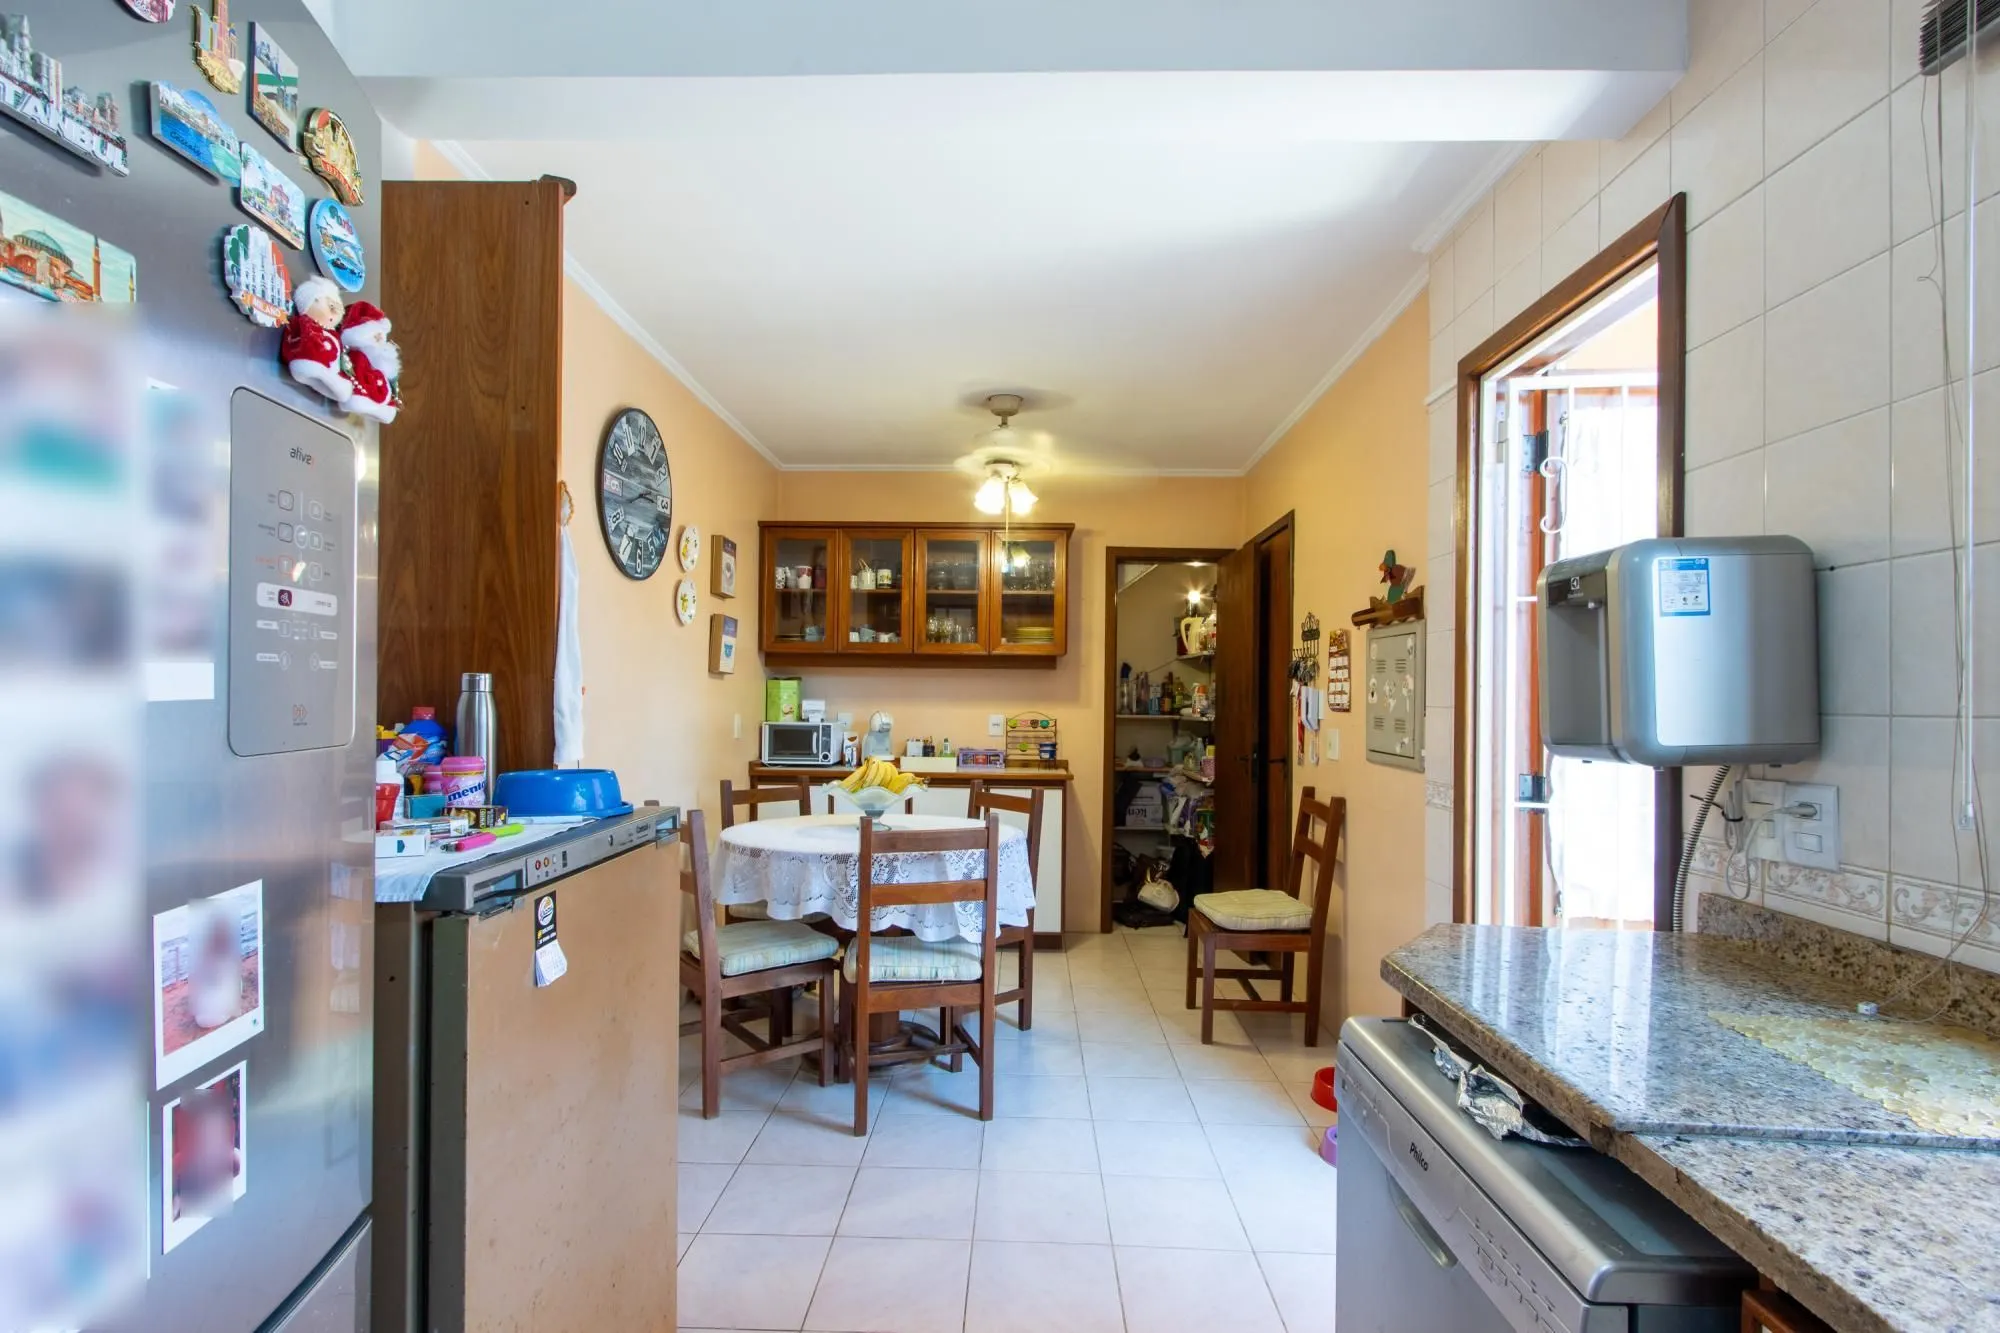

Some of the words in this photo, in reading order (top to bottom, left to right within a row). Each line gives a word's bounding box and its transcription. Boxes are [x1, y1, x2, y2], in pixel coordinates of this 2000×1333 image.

[611, 511, 621, 524] 8
[622, 540, 631, 556] 7
[1409, 1142, 1429, 1171] Philco
